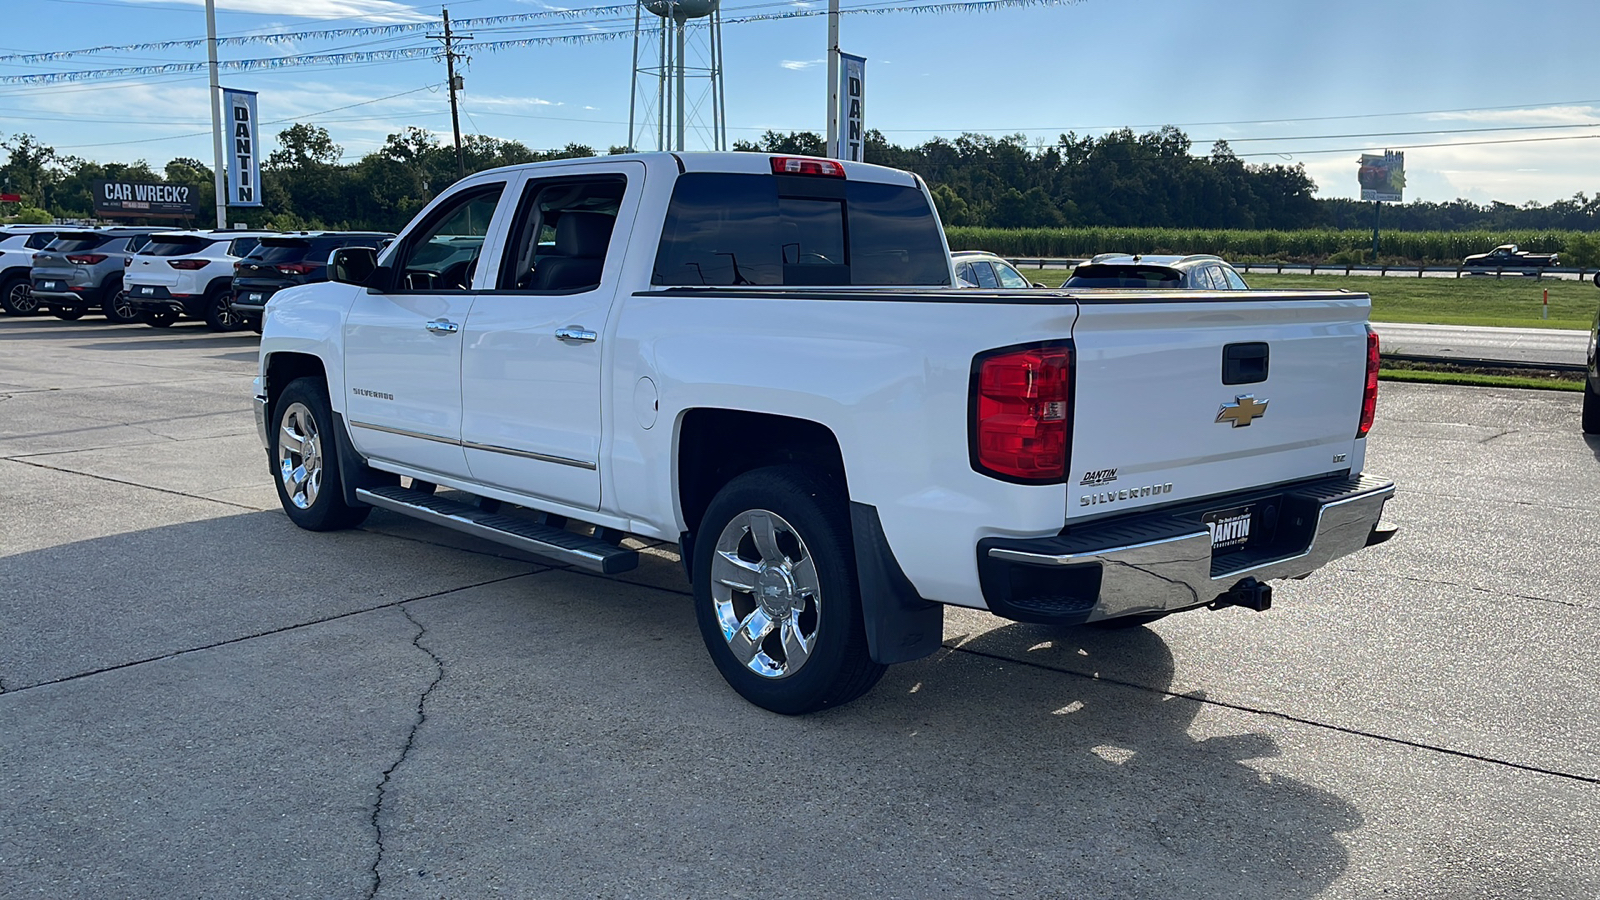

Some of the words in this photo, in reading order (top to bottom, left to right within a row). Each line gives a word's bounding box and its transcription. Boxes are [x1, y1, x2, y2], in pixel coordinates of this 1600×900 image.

[234, 106, 252, 202] DANTIN
[104, 183, 132, 201] CAR
[134, 184, 189, 203] WRECK?
[352, 387, 394, 401] SILVERADO
[1083, 468, 1118, 481] DANTIN
[1080, 482, 1173, 507] SILVERADO
